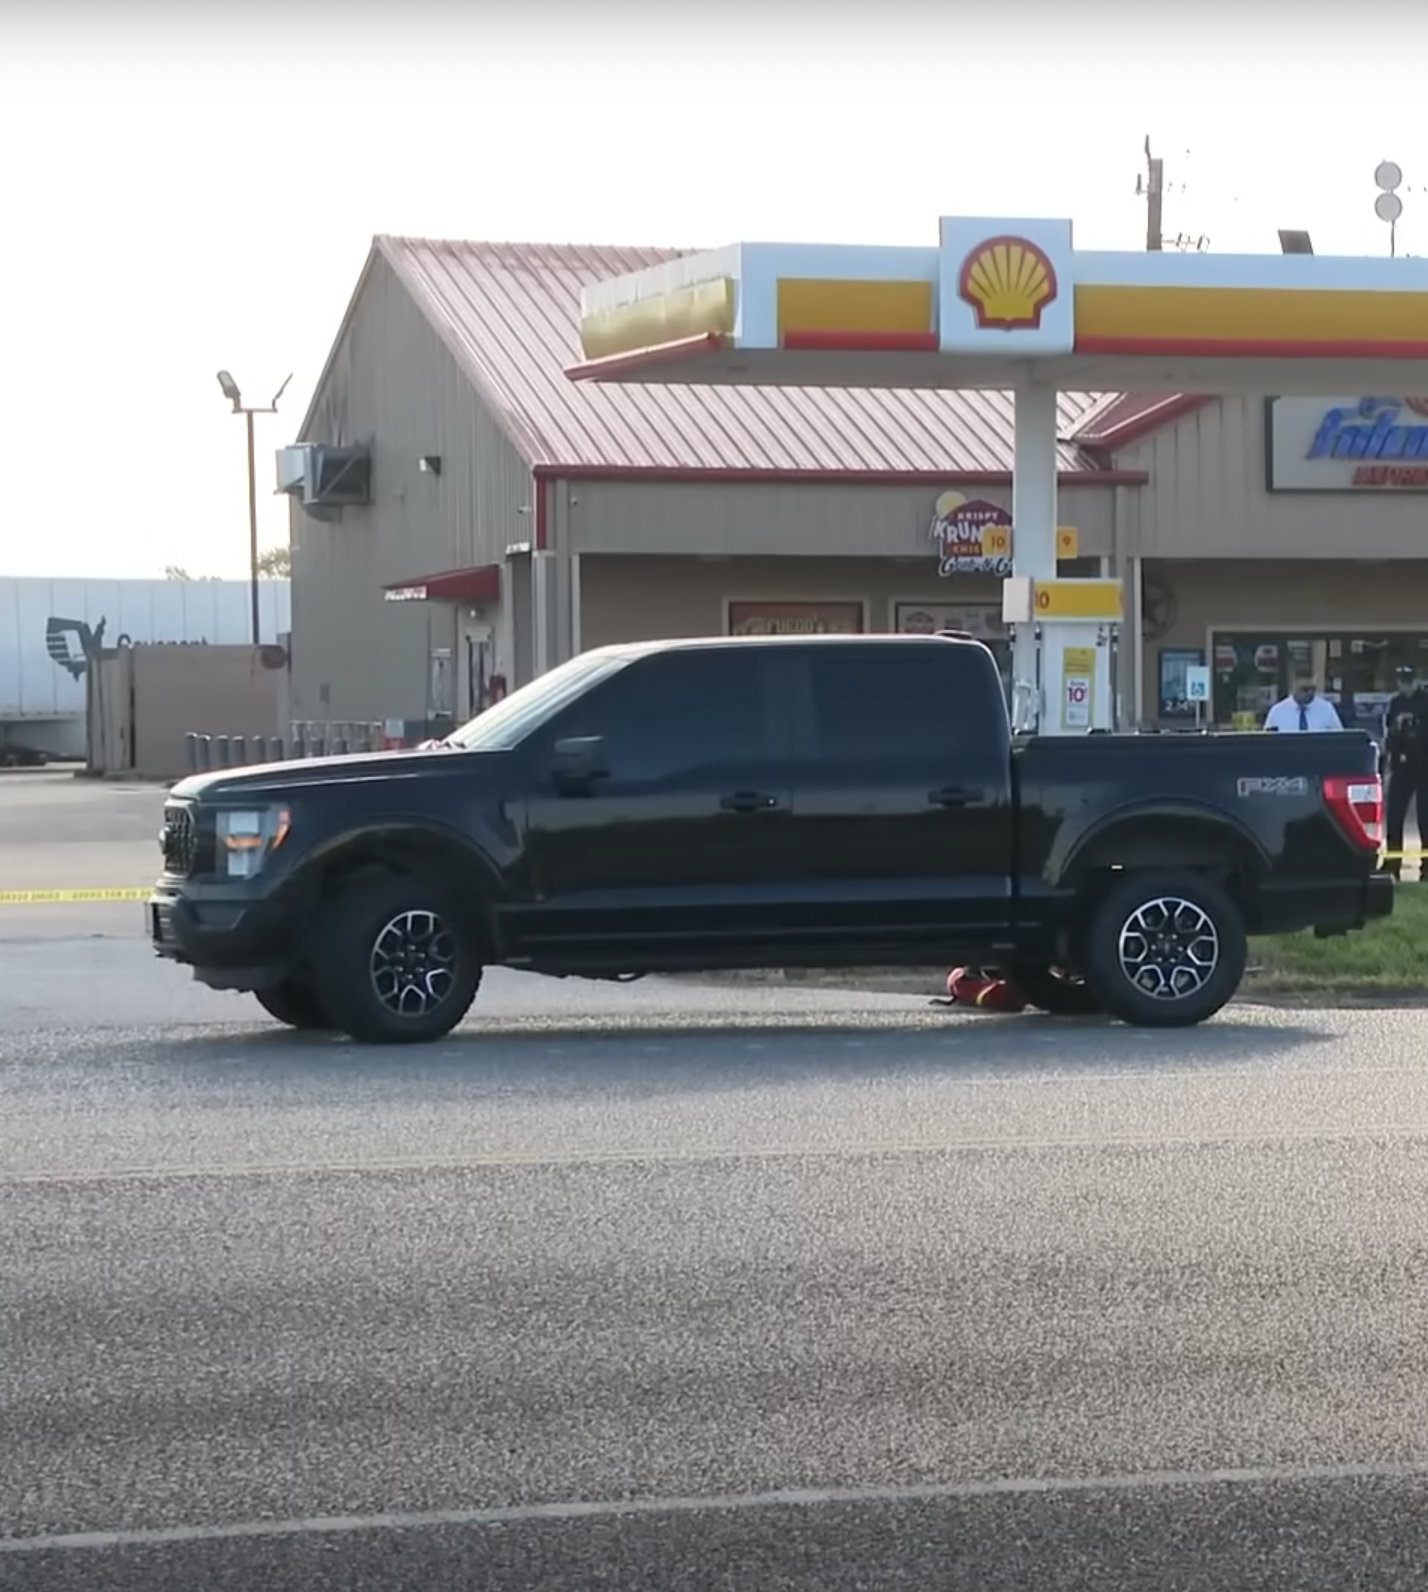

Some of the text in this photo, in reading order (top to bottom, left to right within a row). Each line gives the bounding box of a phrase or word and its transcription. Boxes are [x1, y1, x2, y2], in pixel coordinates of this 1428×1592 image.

[956, 511, 999, 521] KRISPY
[934, 520, 990, 545] KRUN
[991, 536, 1005, 548] 10
[1034, 591, 1051, 609] 10
